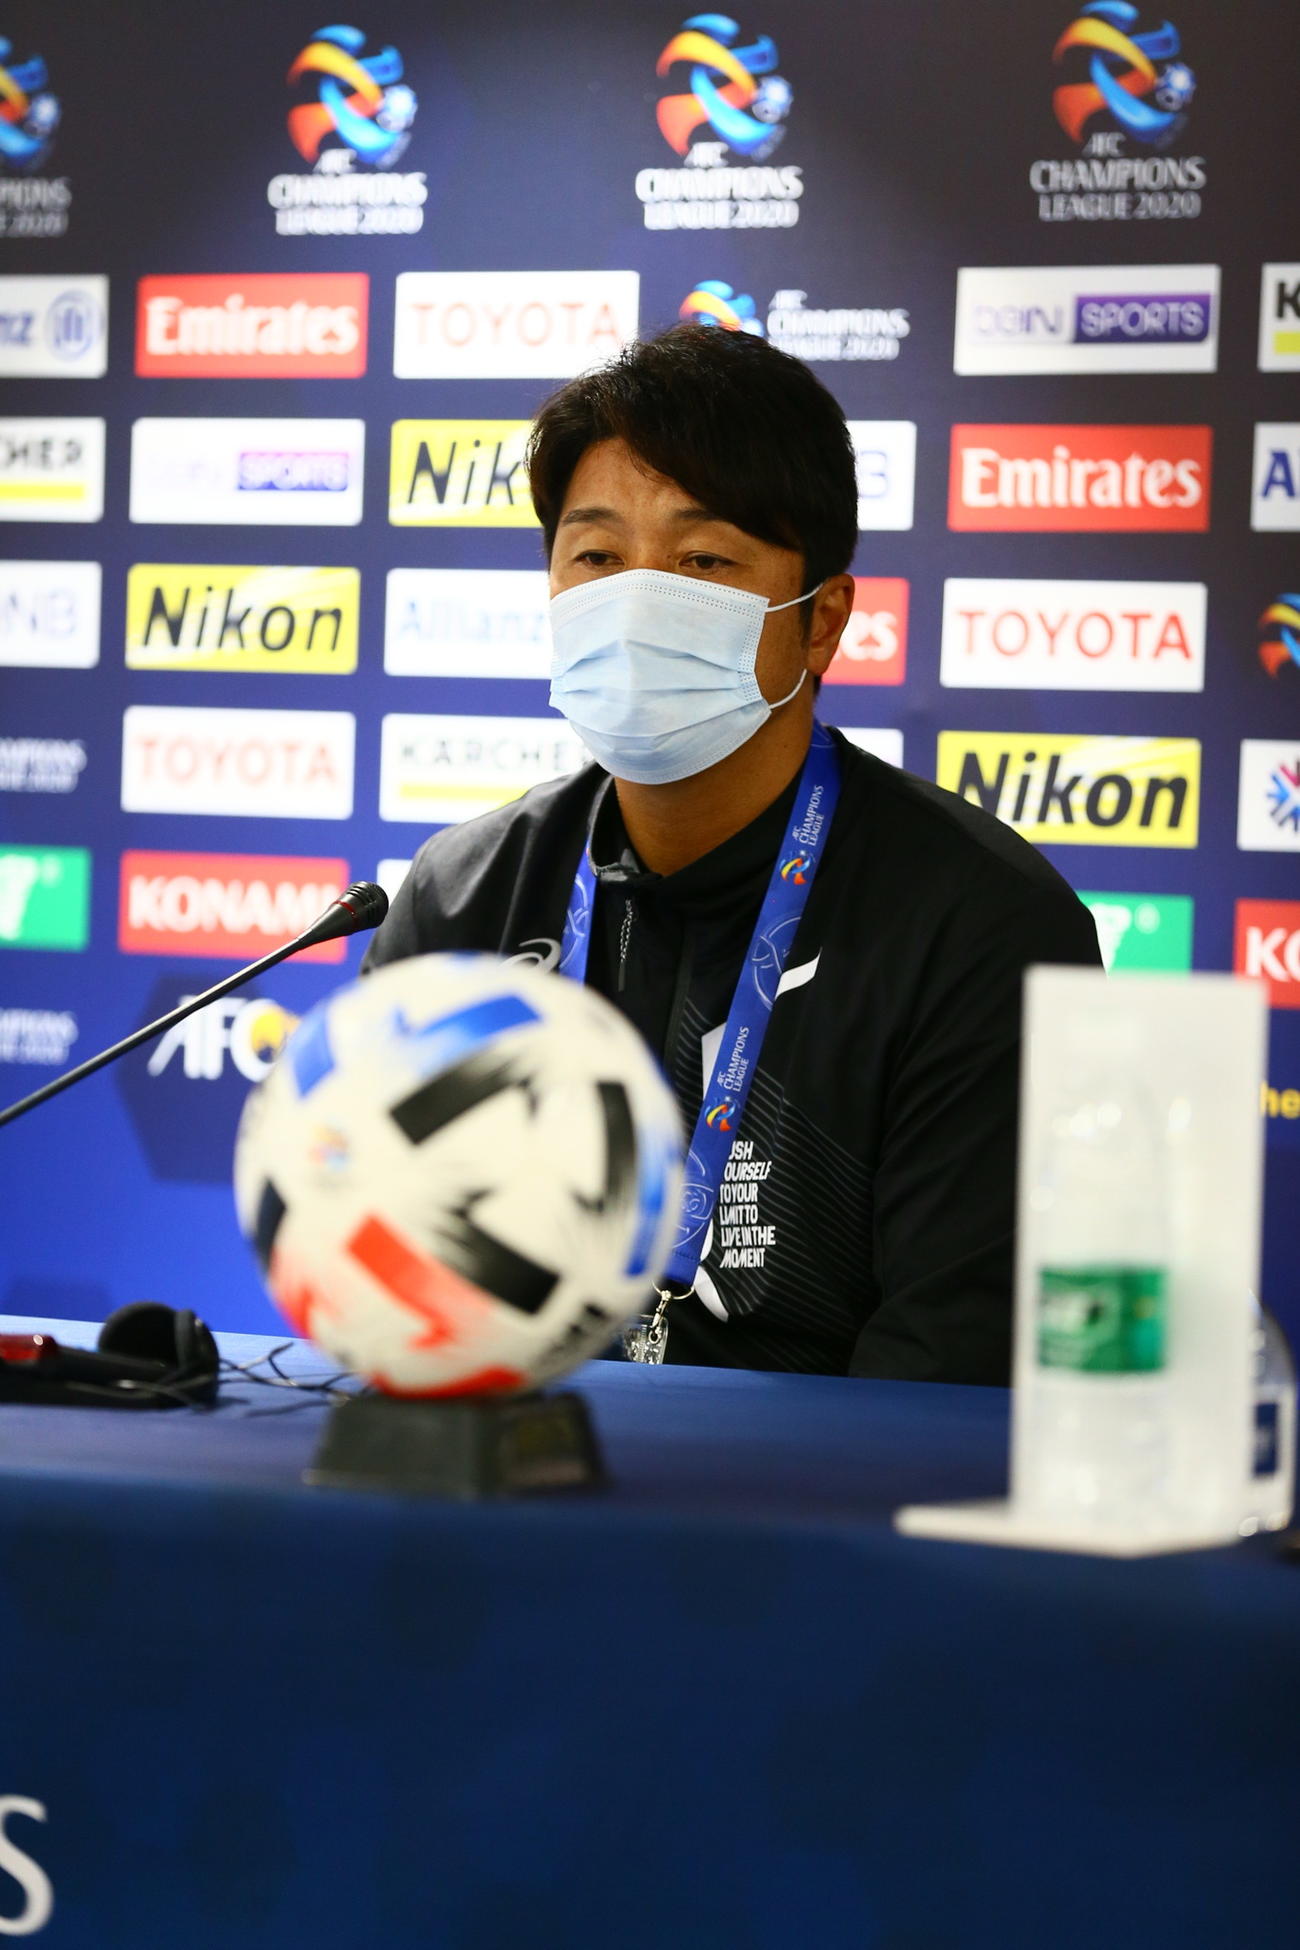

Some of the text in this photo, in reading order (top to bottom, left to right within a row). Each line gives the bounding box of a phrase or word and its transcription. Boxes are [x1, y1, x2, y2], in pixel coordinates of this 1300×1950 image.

[1029, 156, 1206, 193] CHAMPIONS
[1038, 191, 1201, 221] LEAGUE 2020
[146, 293, 360, 355] Emirates
[410, 301, 624, 348] TOYOTA
[1080, 301, 1205, 337] SPORTS
[408, 440, 522, 506] Nik
[961, 445, 1202, 509] Emirates
[143, 585, 344, 652] Nikon
[957, 611, 1191, 660] TOYOTA
[136, 737, 340, 785] TOYOTA
[956, 751, 1188, 829] Nikon
[799, 785, 824, 844] CHAMPIONS
[808, 814, 825, 847] LEAGUE
[723, 1026, 750, 1090] CHAMPIONS
[732, 1057, 749, 1092] LEAGUE
[724, 1160, 772, 1181] OURSELF
[720, 1248, 765, 1268] MOMENT
